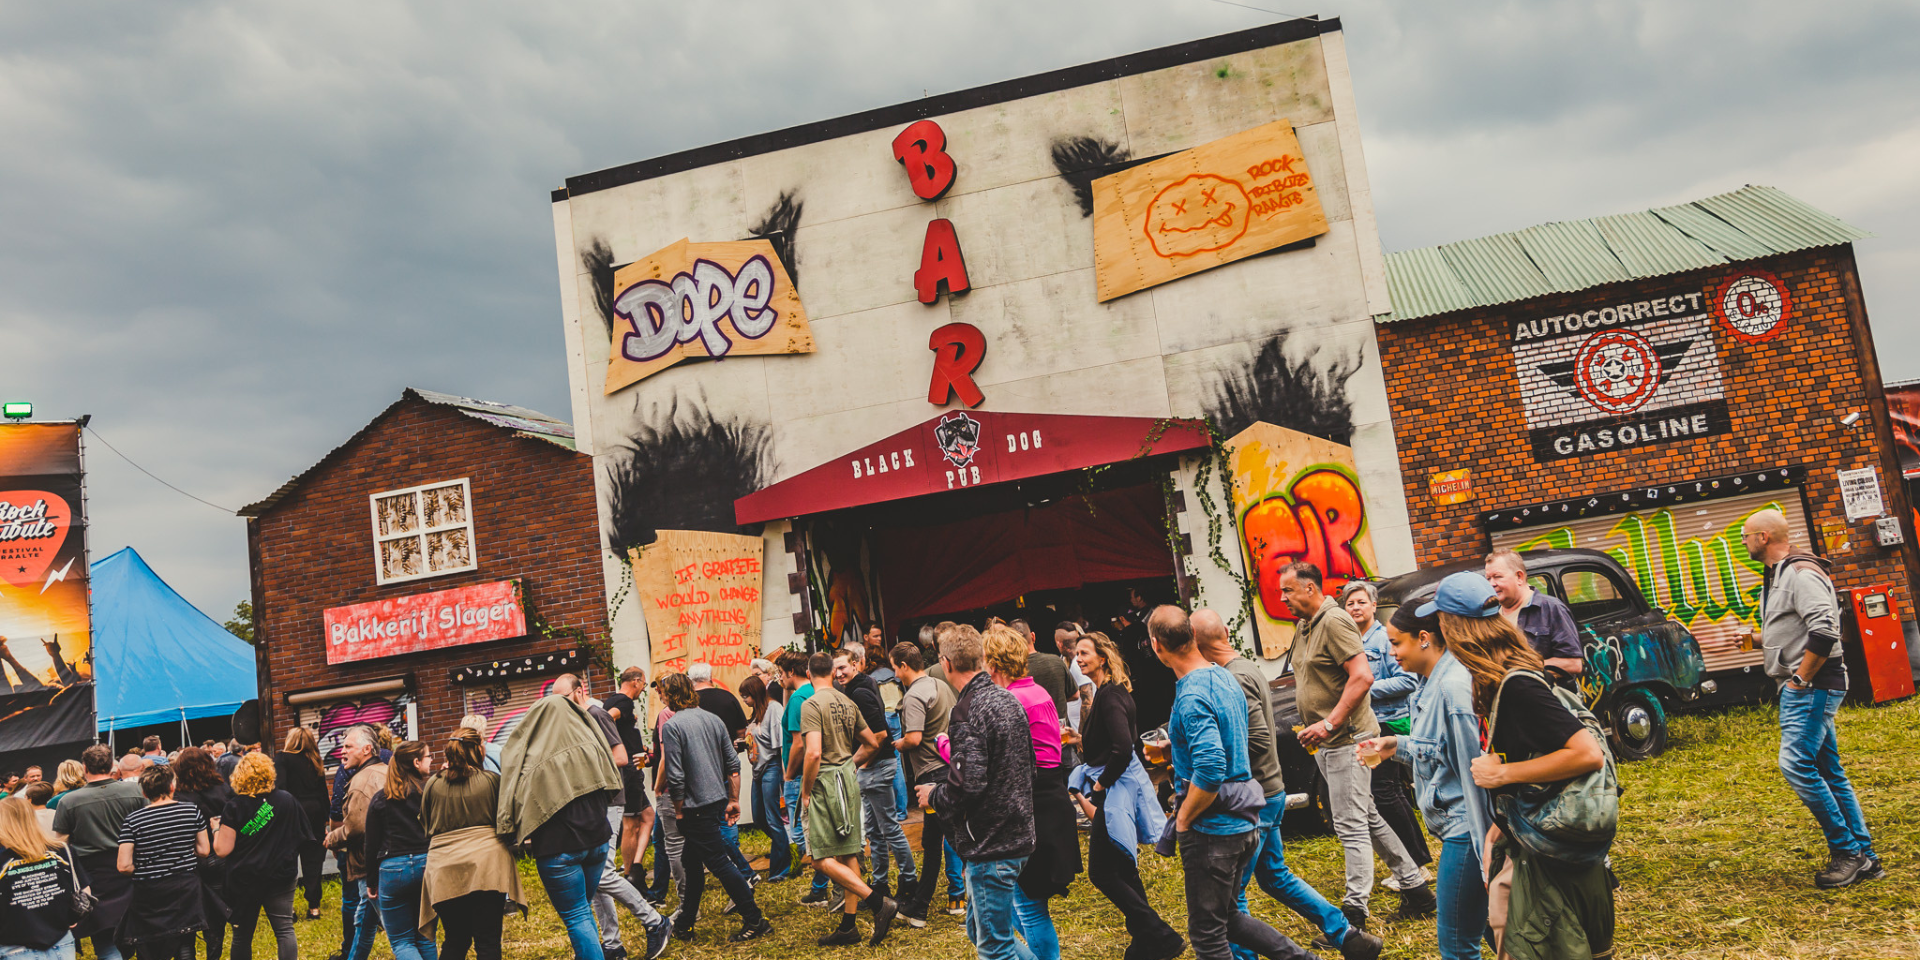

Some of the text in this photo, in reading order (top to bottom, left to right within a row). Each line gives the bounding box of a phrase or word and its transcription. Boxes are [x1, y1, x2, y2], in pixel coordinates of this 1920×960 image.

[1247, 154, 1295, 181] ROCK
[1247, 173, 1309, 198] TRIBUTE
[892, 120, 987, 409] BAR
[1514, 292, 1702, 341] AUTOCORRECT
[1553, 413, 1709, 455] GASOLINE
[851, 430, 1042, 479] BLACK DOG
[945, 466, 981, 489] PUB
[1431, 480, 1470, 495] MICHELIN
[675, 558, 761, 585] IF GRAFFITI
[655, 584, 759, 609] WOULD CHANGE
[1858, 602, 1864, 613] 2
[331, 602, 517, 645] Bakkerij Slager
[663, 628, 743, 652] IT WOULD
